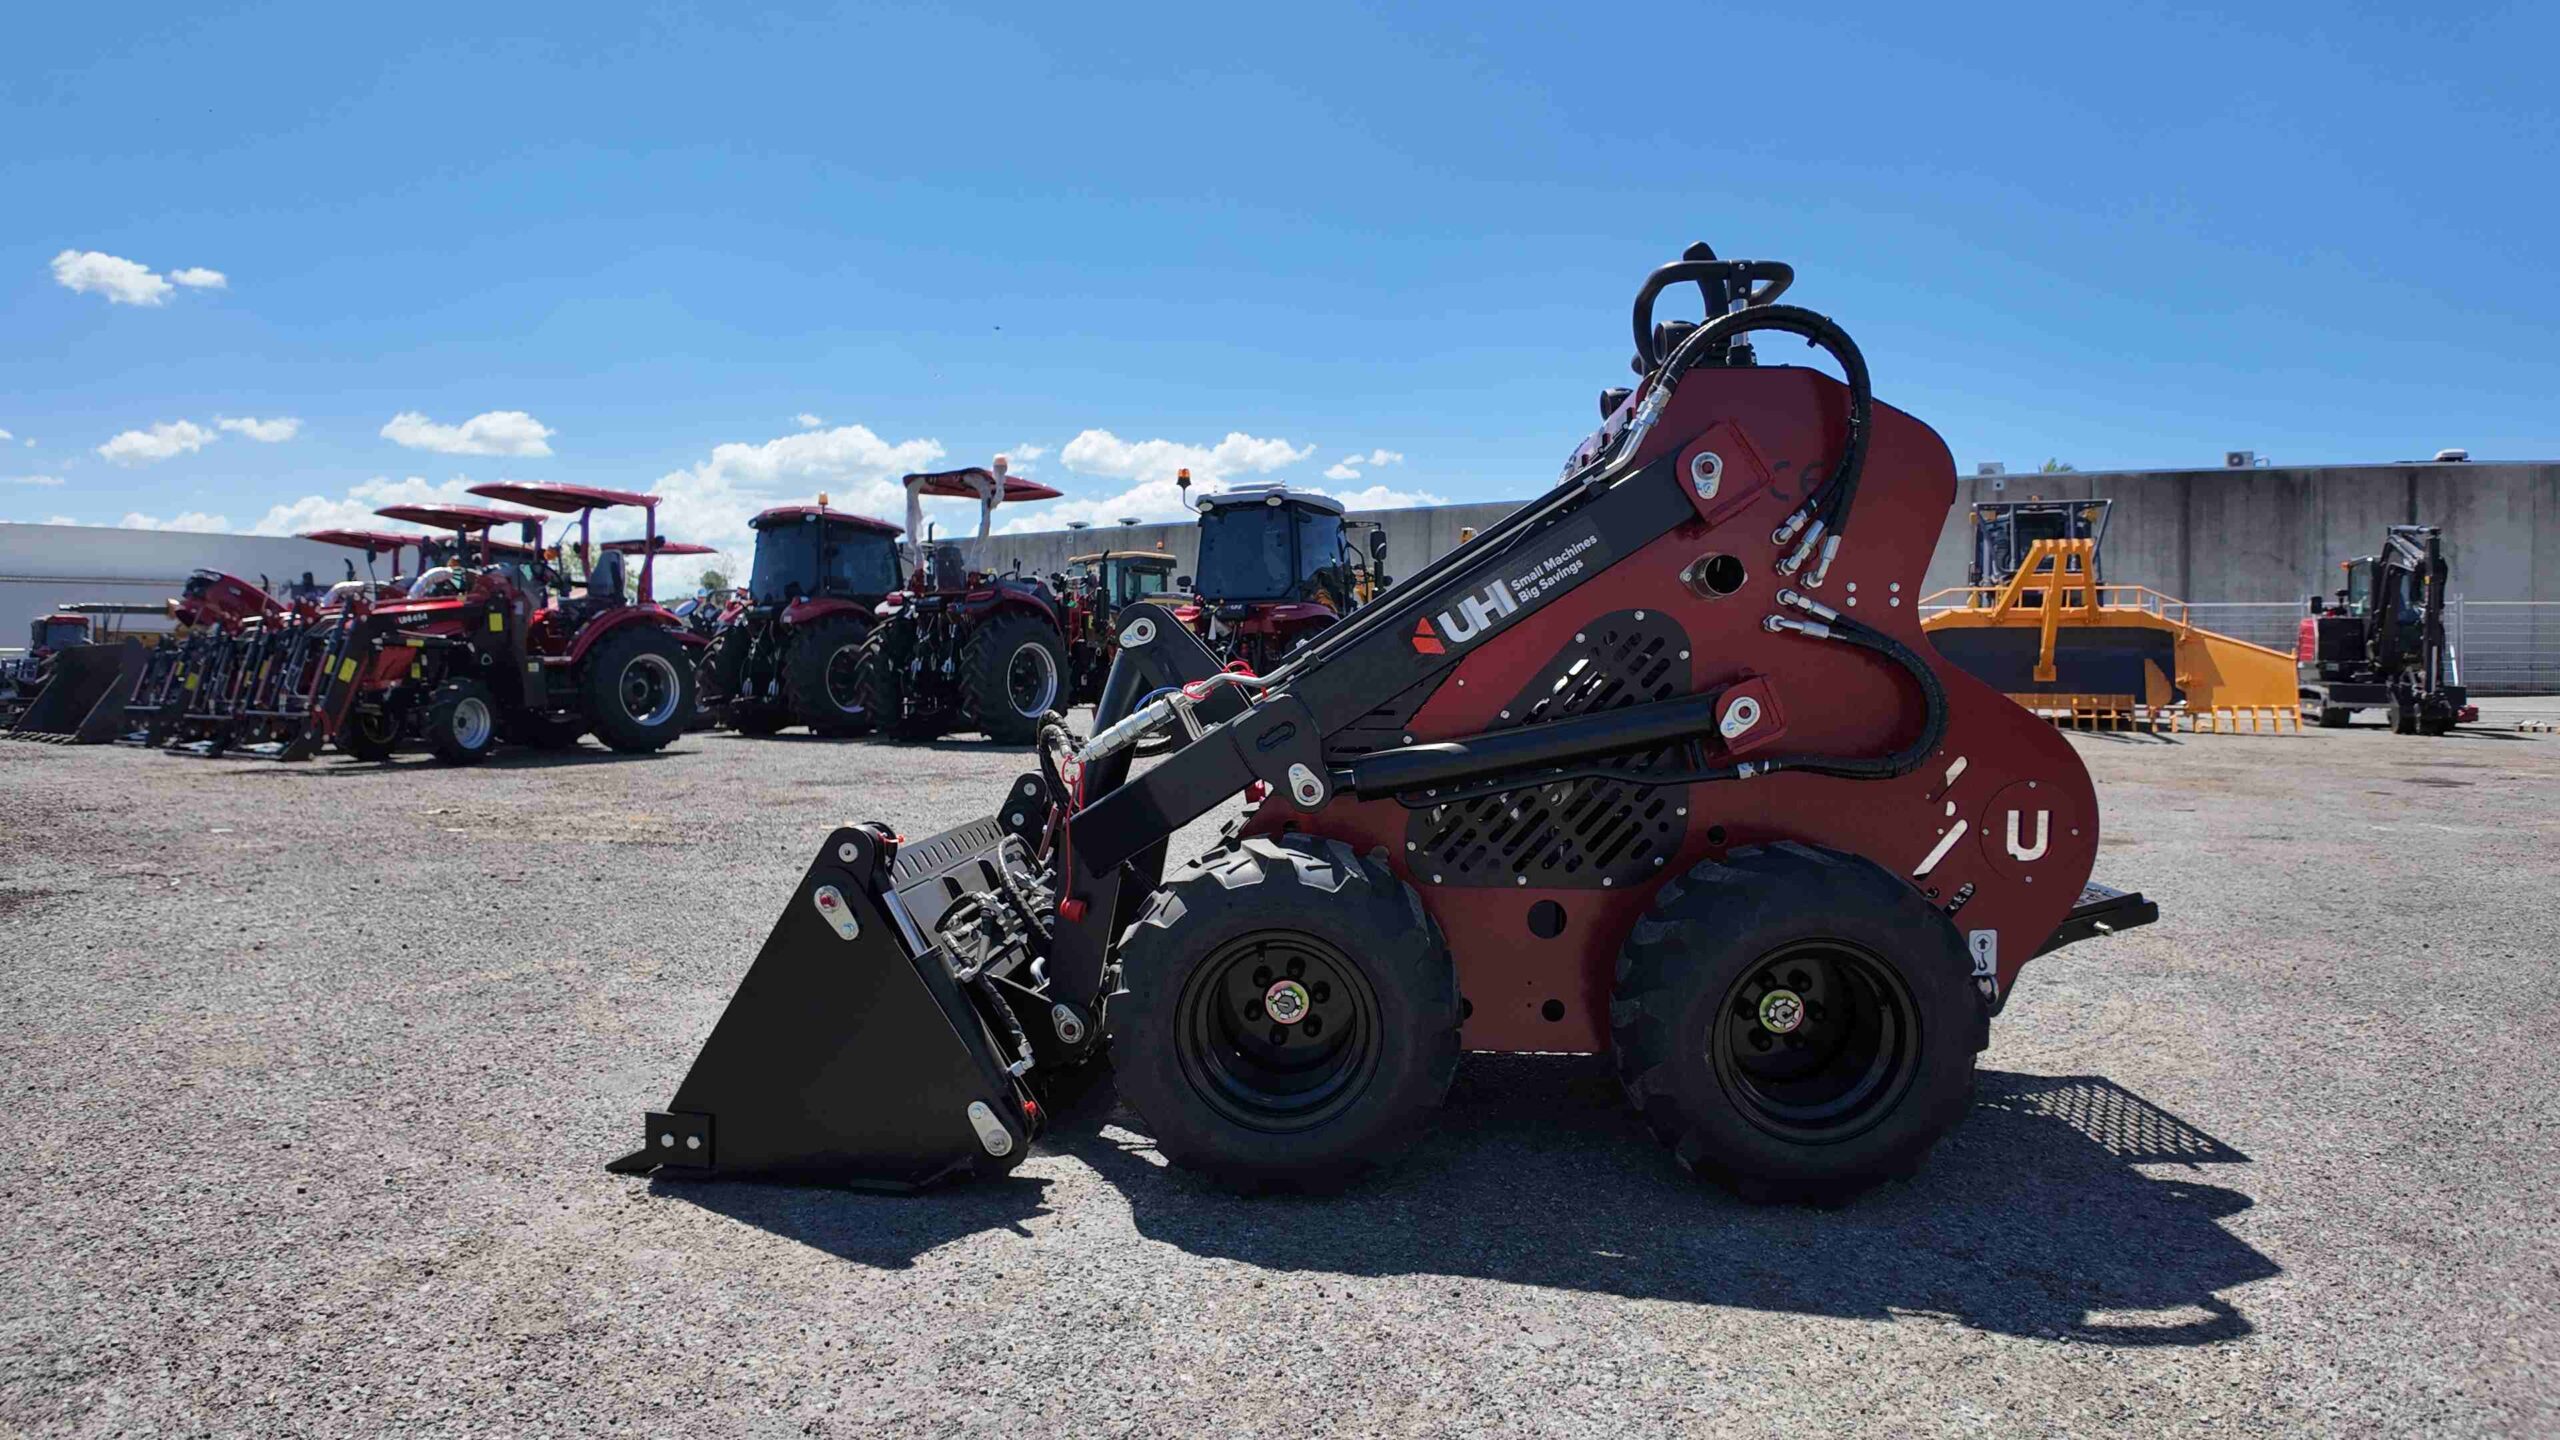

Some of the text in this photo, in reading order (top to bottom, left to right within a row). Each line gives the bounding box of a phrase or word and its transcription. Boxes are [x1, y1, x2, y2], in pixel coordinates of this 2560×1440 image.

[1510, 535, 1598, 591] Small Machines
[1517, 559, 1584, 603] Big Savings
[1436, 578, 1519, 643] UHI
[2006, 809, 2050, 862] U
